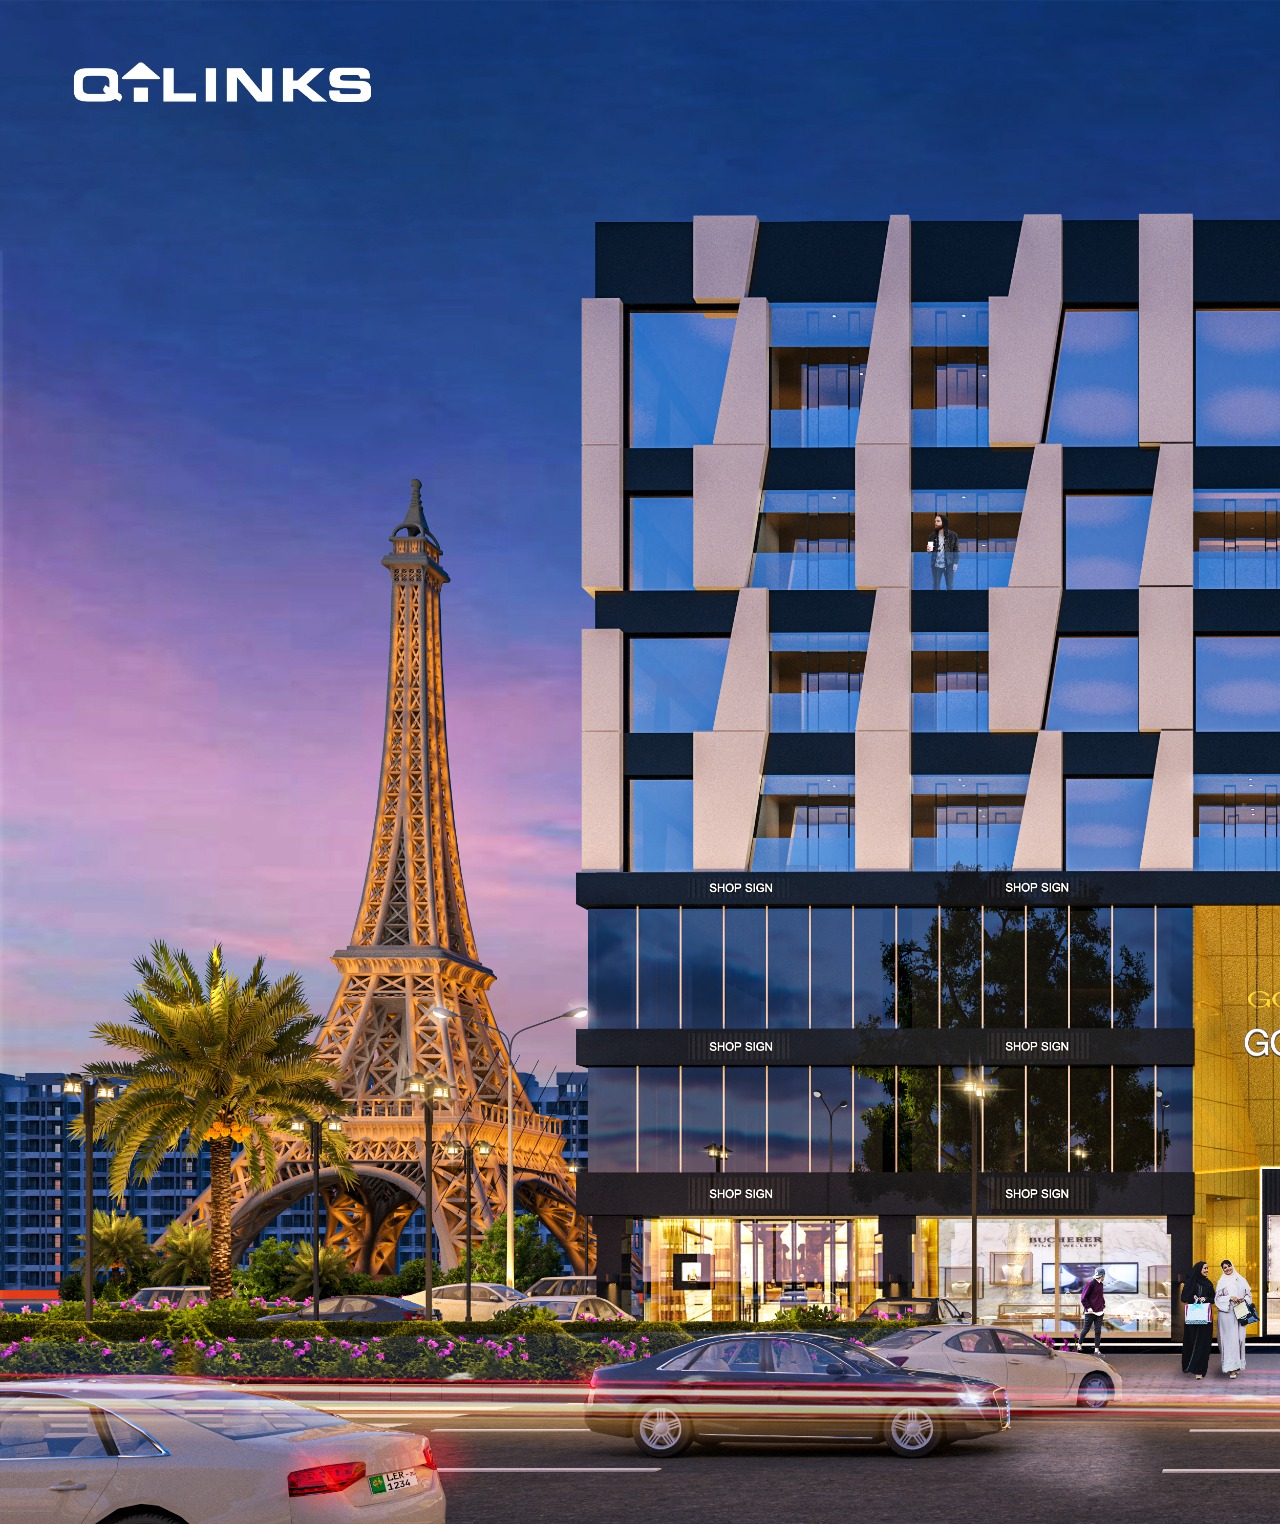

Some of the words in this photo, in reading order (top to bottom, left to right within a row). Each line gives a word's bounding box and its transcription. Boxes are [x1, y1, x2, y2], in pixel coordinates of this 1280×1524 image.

[709, 882, 742, 893] SHOP
[744, 882, 773, 893] SIGN
[1005, 882, 1038, 893] SHOP
[1040, 882, 1069, 893] SIGN
[709, 1041, 742, 1052] SHOP
[744, 1041, 773, 1052] SIGN
[1005, 1041, 1038, 1052] SHOP
[1040, 1041, 1069, 1052] SIGN
[709, 1188, 742, 1199] SHOP
[744, 1188, 773, 1199] SIGN
[1005, 1188, 1038, 1199] SHOP
[1040, 1188, 1069, 1199] SIGN
[386, 1471, 405, 1482] LER
[387, 1479, 411, 1491] 1234
